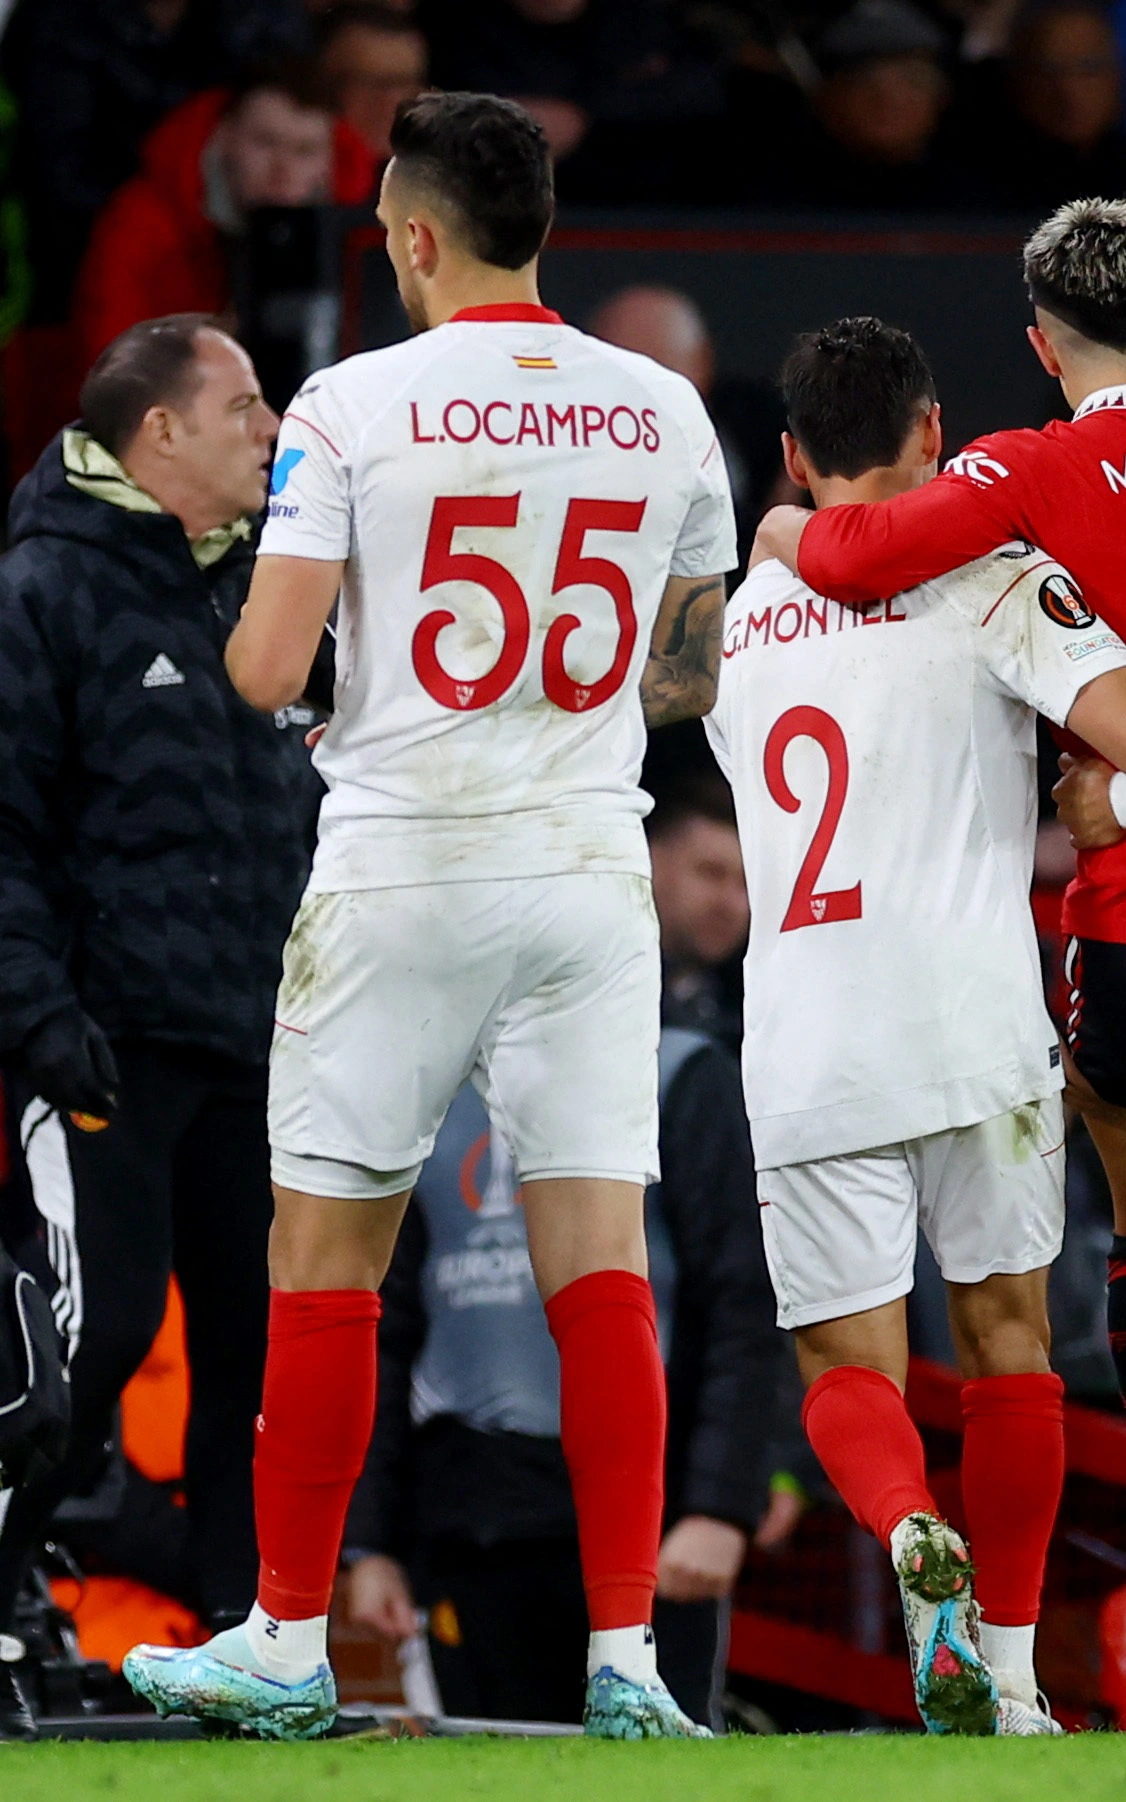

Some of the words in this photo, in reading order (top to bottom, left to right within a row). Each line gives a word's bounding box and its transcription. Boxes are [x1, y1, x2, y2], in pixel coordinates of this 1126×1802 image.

[410, 399, 660, 453] L.OCAMPOS
[411, 490, 648, 713] 55
[763, 705, 862, 933] 2
